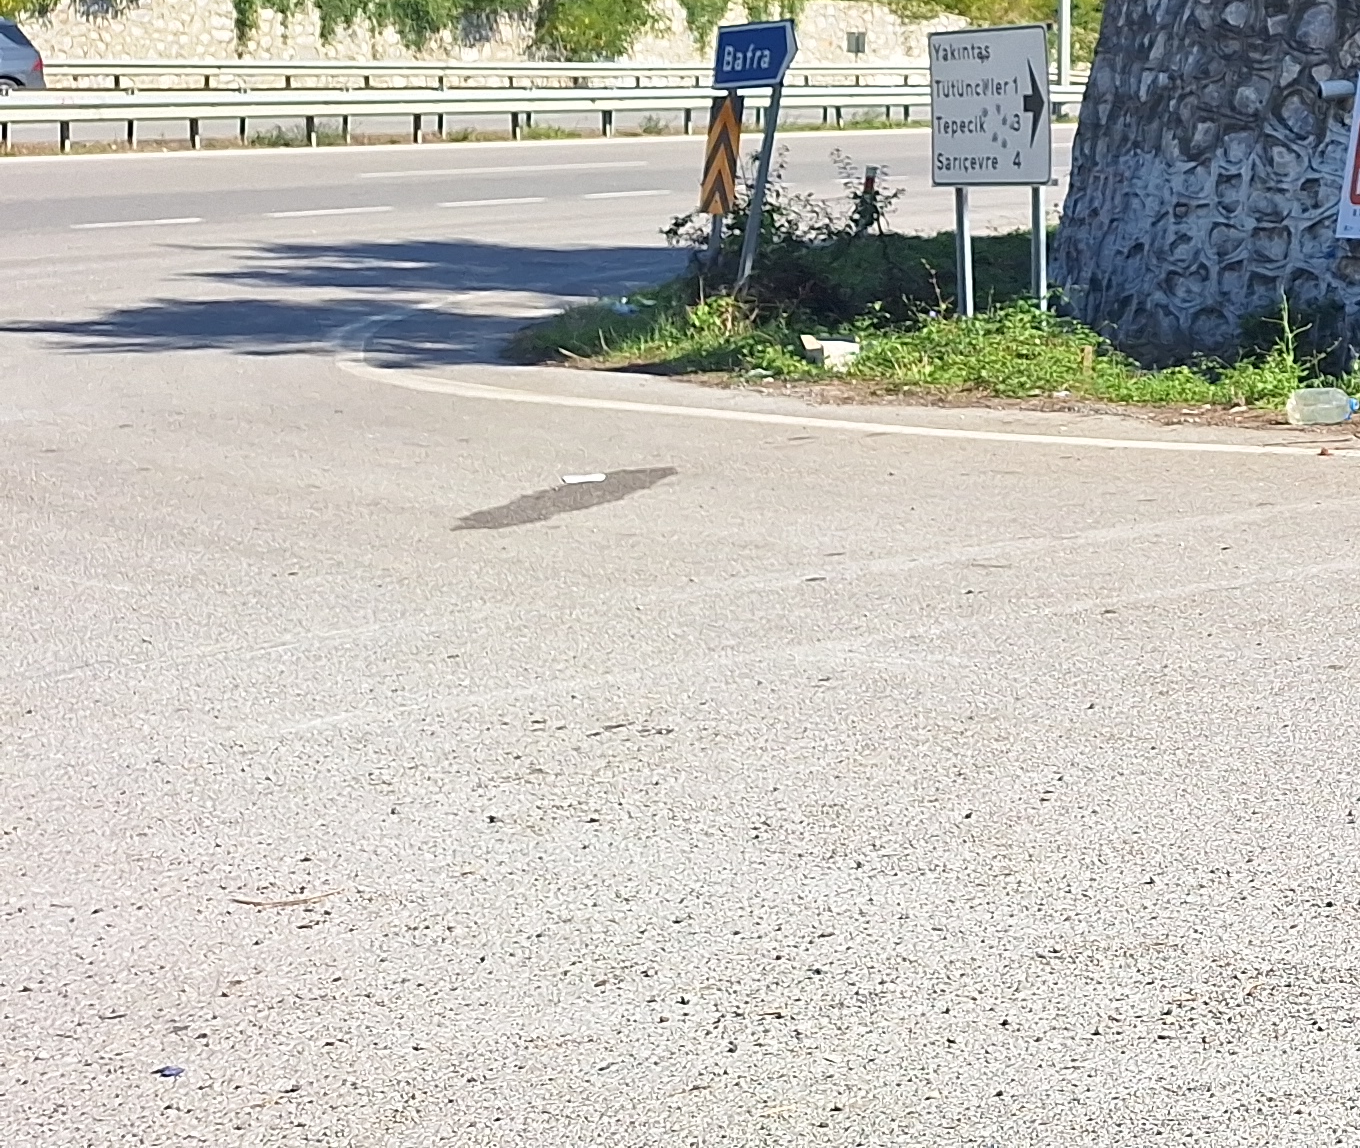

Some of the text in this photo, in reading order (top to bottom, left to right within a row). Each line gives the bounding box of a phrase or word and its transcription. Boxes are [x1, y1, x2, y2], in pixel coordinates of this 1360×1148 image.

[722, 43, 771, 72] Bafra
[1012, 76, 1019, 95] 1
[935, 113, 1022, 138] Tepecik 3
[936, 150, 1022, 173] Sarıçevre 4
